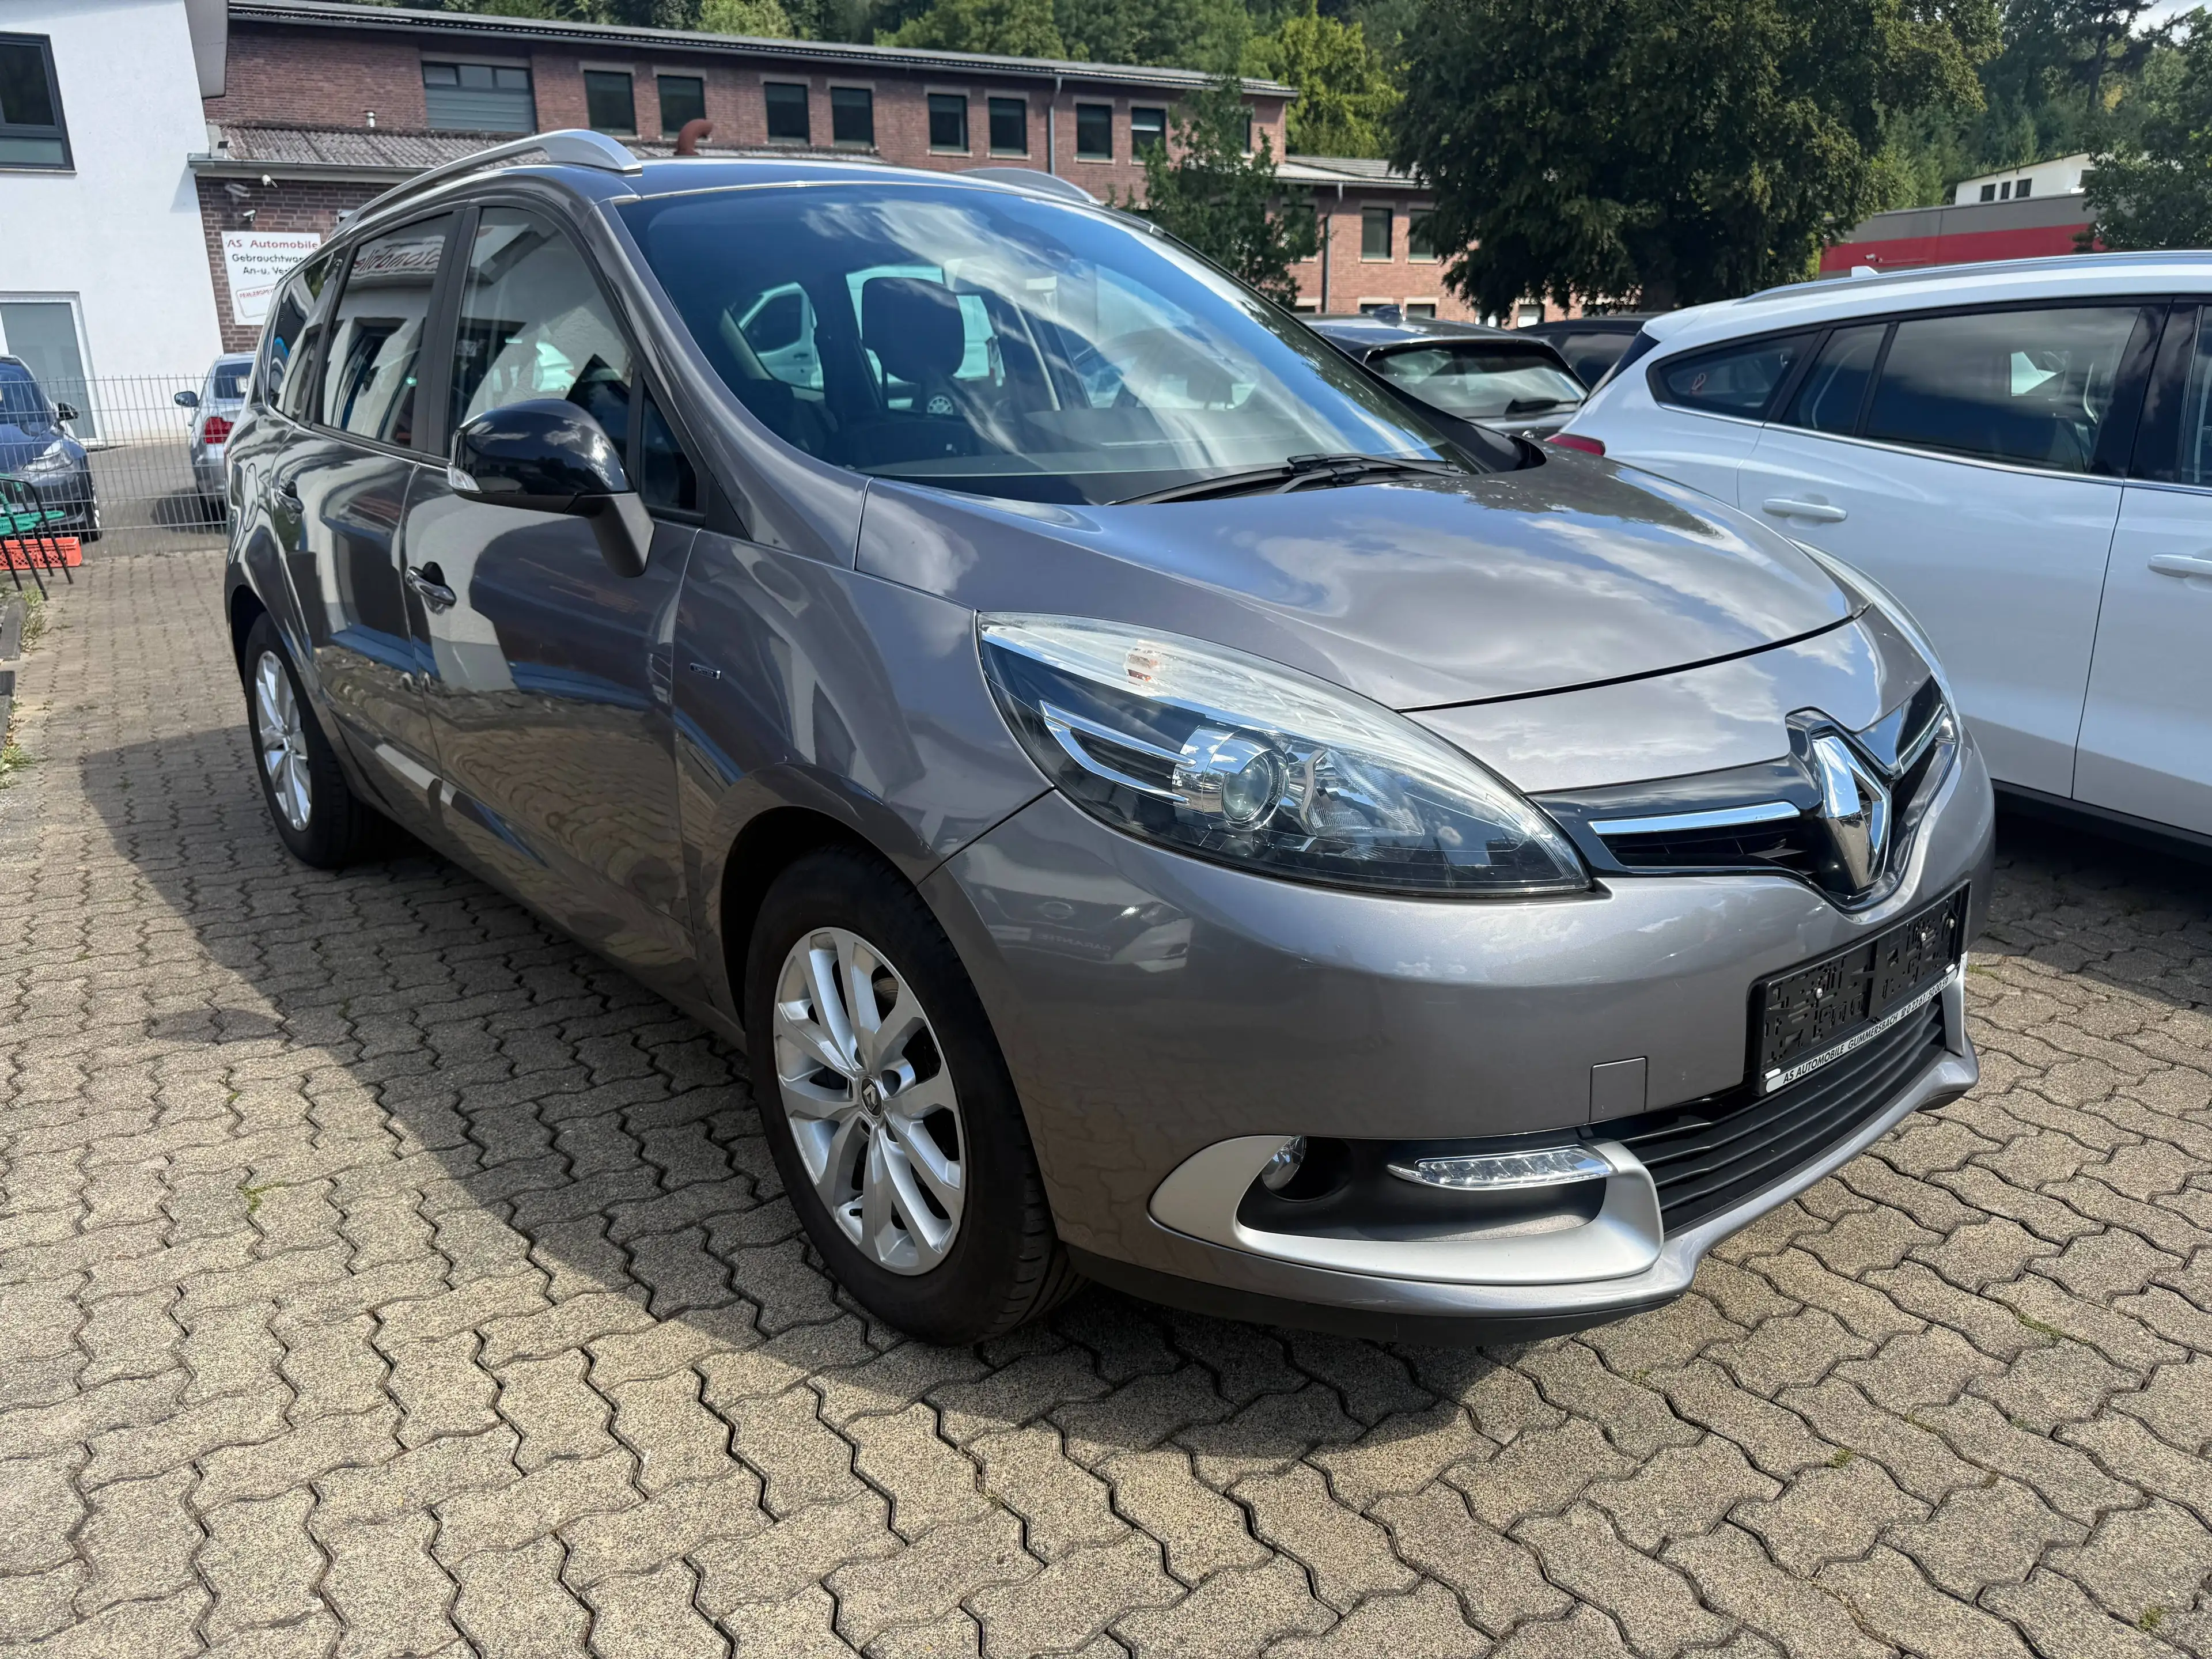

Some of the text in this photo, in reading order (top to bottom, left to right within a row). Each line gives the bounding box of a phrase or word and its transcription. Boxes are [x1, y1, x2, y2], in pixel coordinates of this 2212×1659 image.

[227, 239, 318, 249] AS Automobile
[1783, 1070, 1794, 1084] AS
[1796, 1044, 1844, 1077] AUTOMOBILE
[1848, 1013, 1899, 1050] GUMMERSBACH
